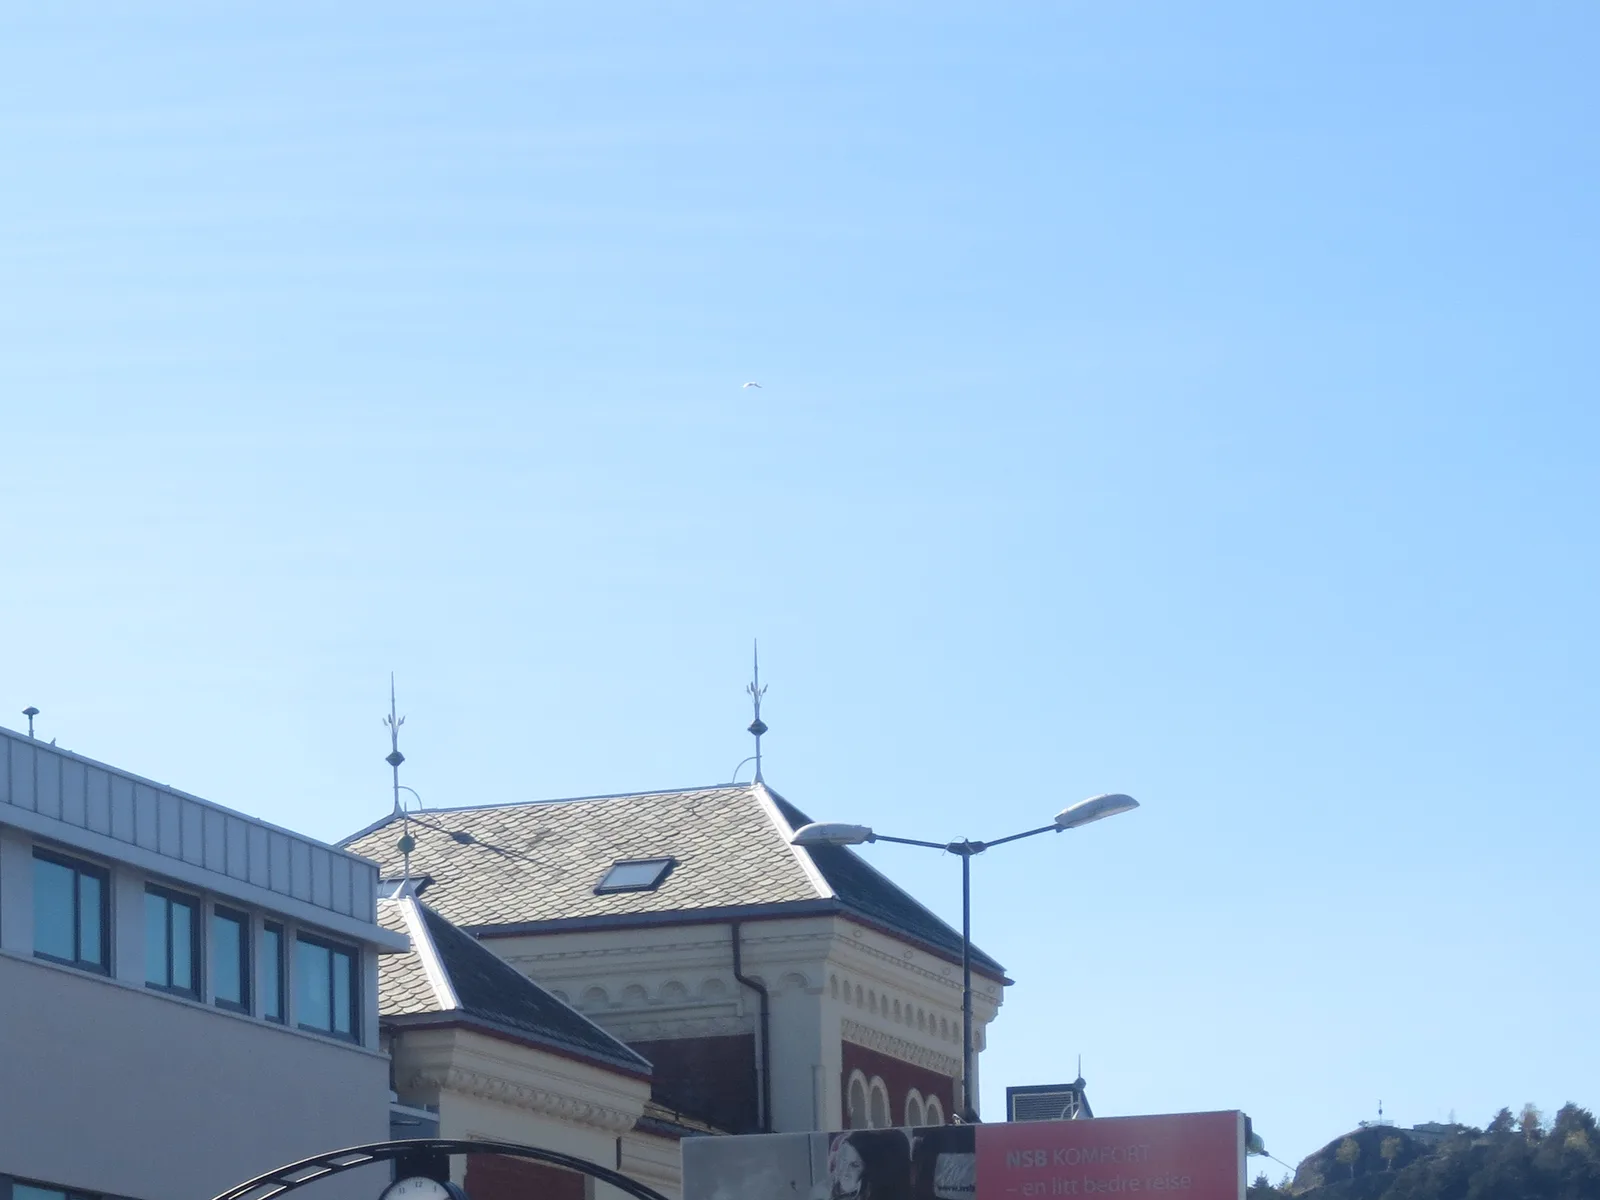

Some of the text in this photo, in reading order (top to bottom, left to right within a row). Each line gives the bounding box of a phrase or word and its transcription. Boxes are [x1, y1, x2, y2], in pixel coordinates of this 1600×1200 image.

[1006, 1144, 1151, 1168] NSB KOMFORT
[1021, 1181, 1046, 1197] en
[1052, 1176, 1078, 1195] litt
[1083, 1174, 1141, 1194] bedre
[1145, 1172, 1192, 1190] reise
